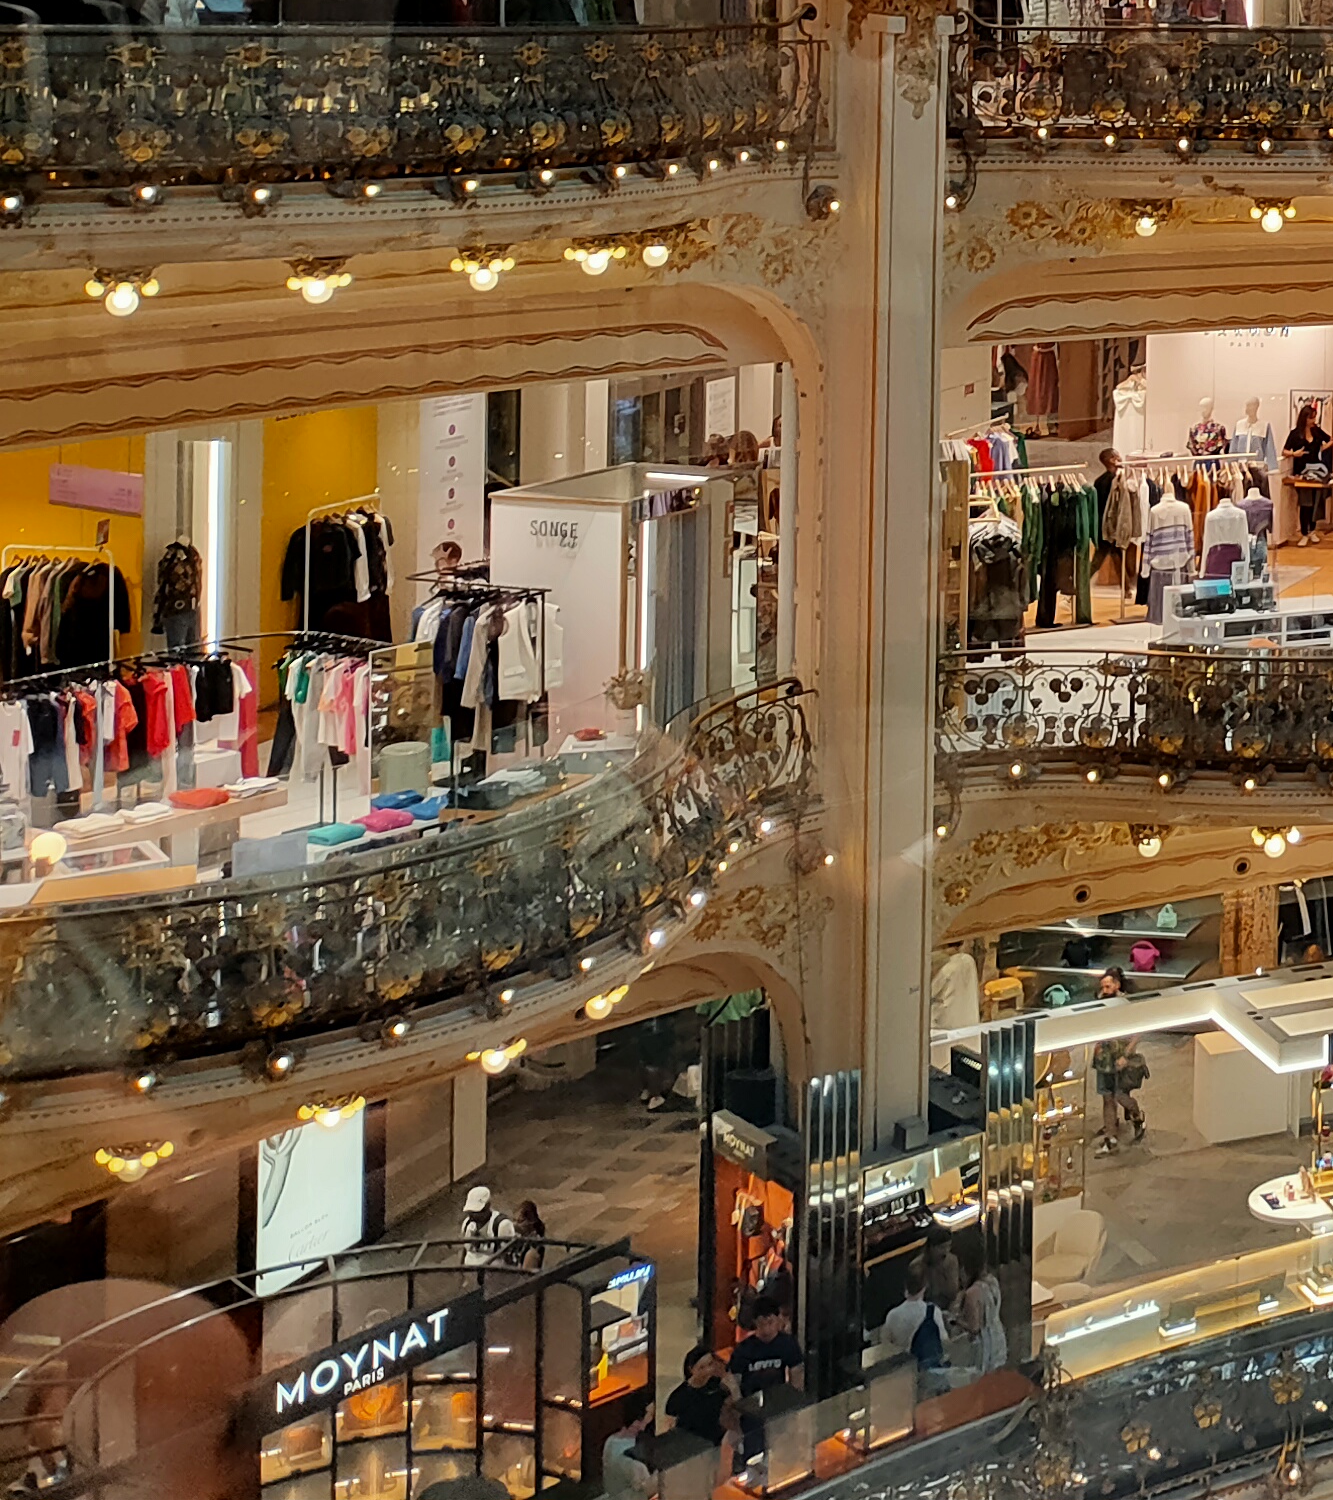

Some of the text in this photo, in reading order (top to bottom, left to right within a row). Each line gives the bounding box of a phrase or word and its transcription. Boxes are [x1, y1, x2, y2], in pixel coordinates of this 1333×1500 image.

[530, 519, 579, 539] SONGE
[276, 1308, 448, 1413] MOYNAT
[343, 1366, 385, 1396] PARIS
